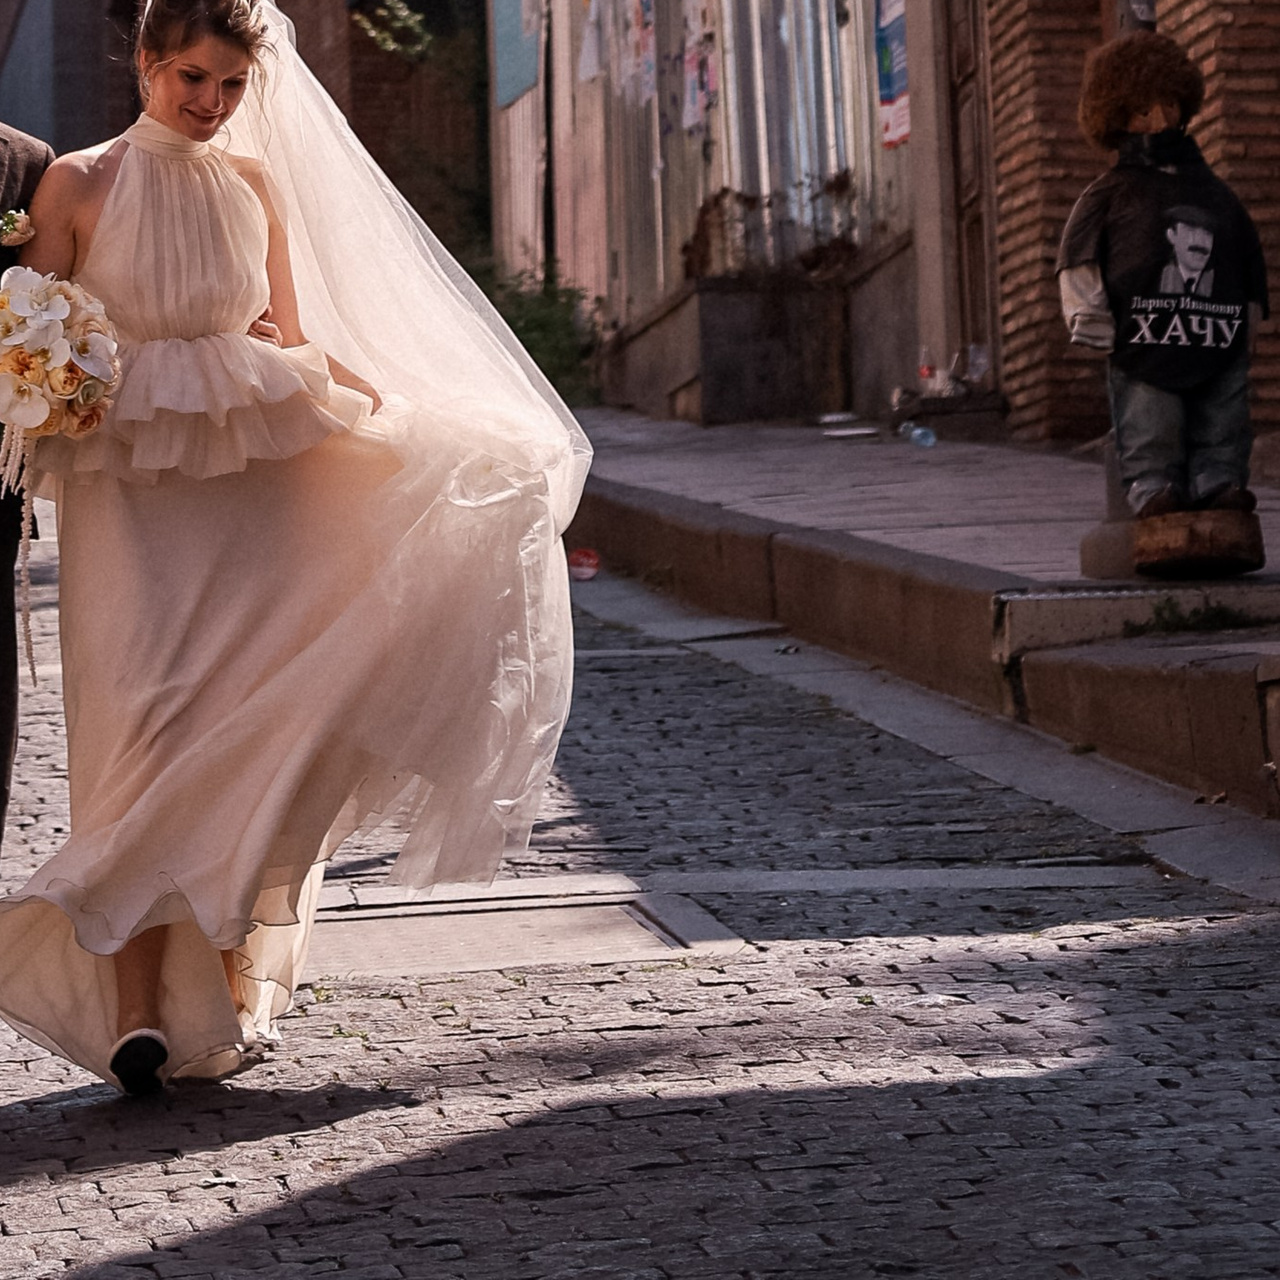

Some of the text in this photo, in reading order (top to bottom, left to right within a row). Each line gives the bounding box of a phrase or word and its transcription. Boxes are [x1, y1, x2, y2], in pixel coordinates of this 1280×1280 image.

[1131, 295, 1241, 317] Ларису Ивановну
[1130, 313, 1242, 349] ХАЧУ
